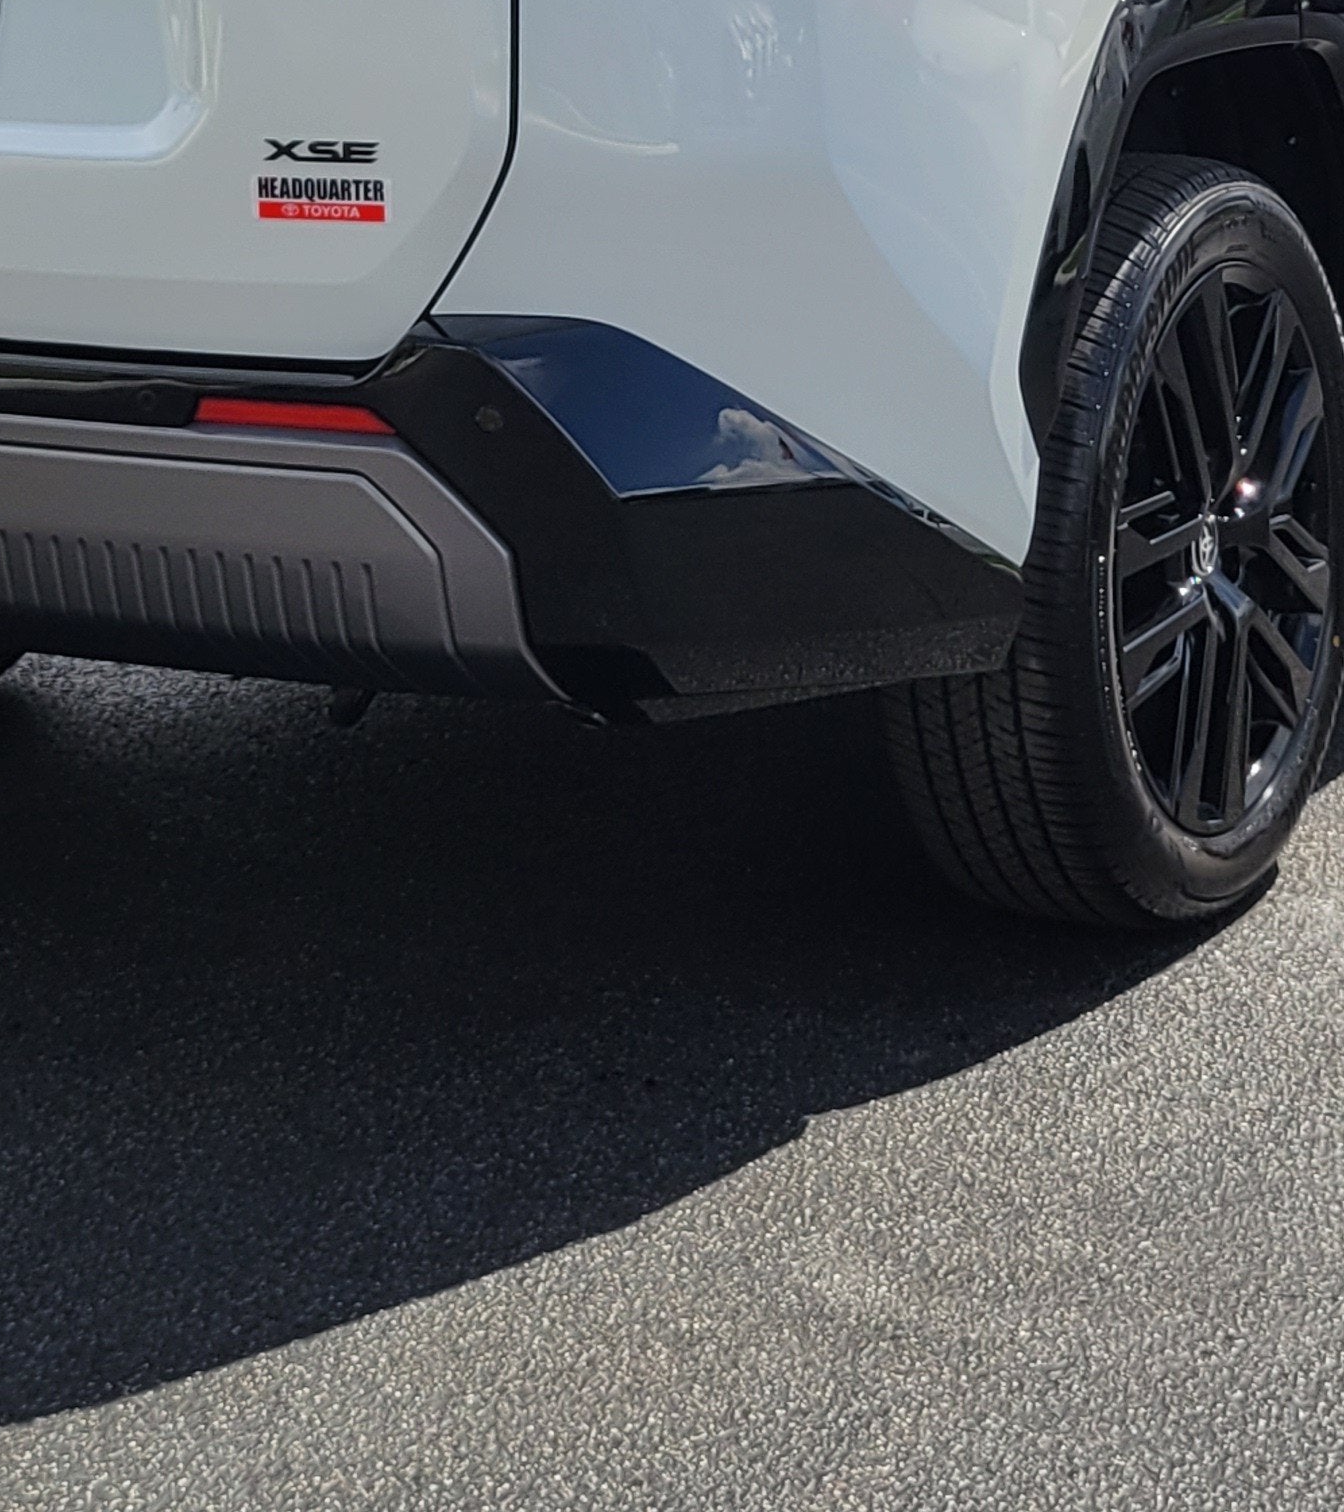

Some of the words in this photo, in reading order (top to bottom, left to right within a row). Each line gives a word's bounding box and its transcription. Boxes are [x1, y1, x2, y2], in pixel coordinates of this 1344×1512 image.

[263, 138, 380, 163] XSE
[257, 176, 384, 202] HEADQUARTER
[301, 205, 361, 219] TOYOTA
